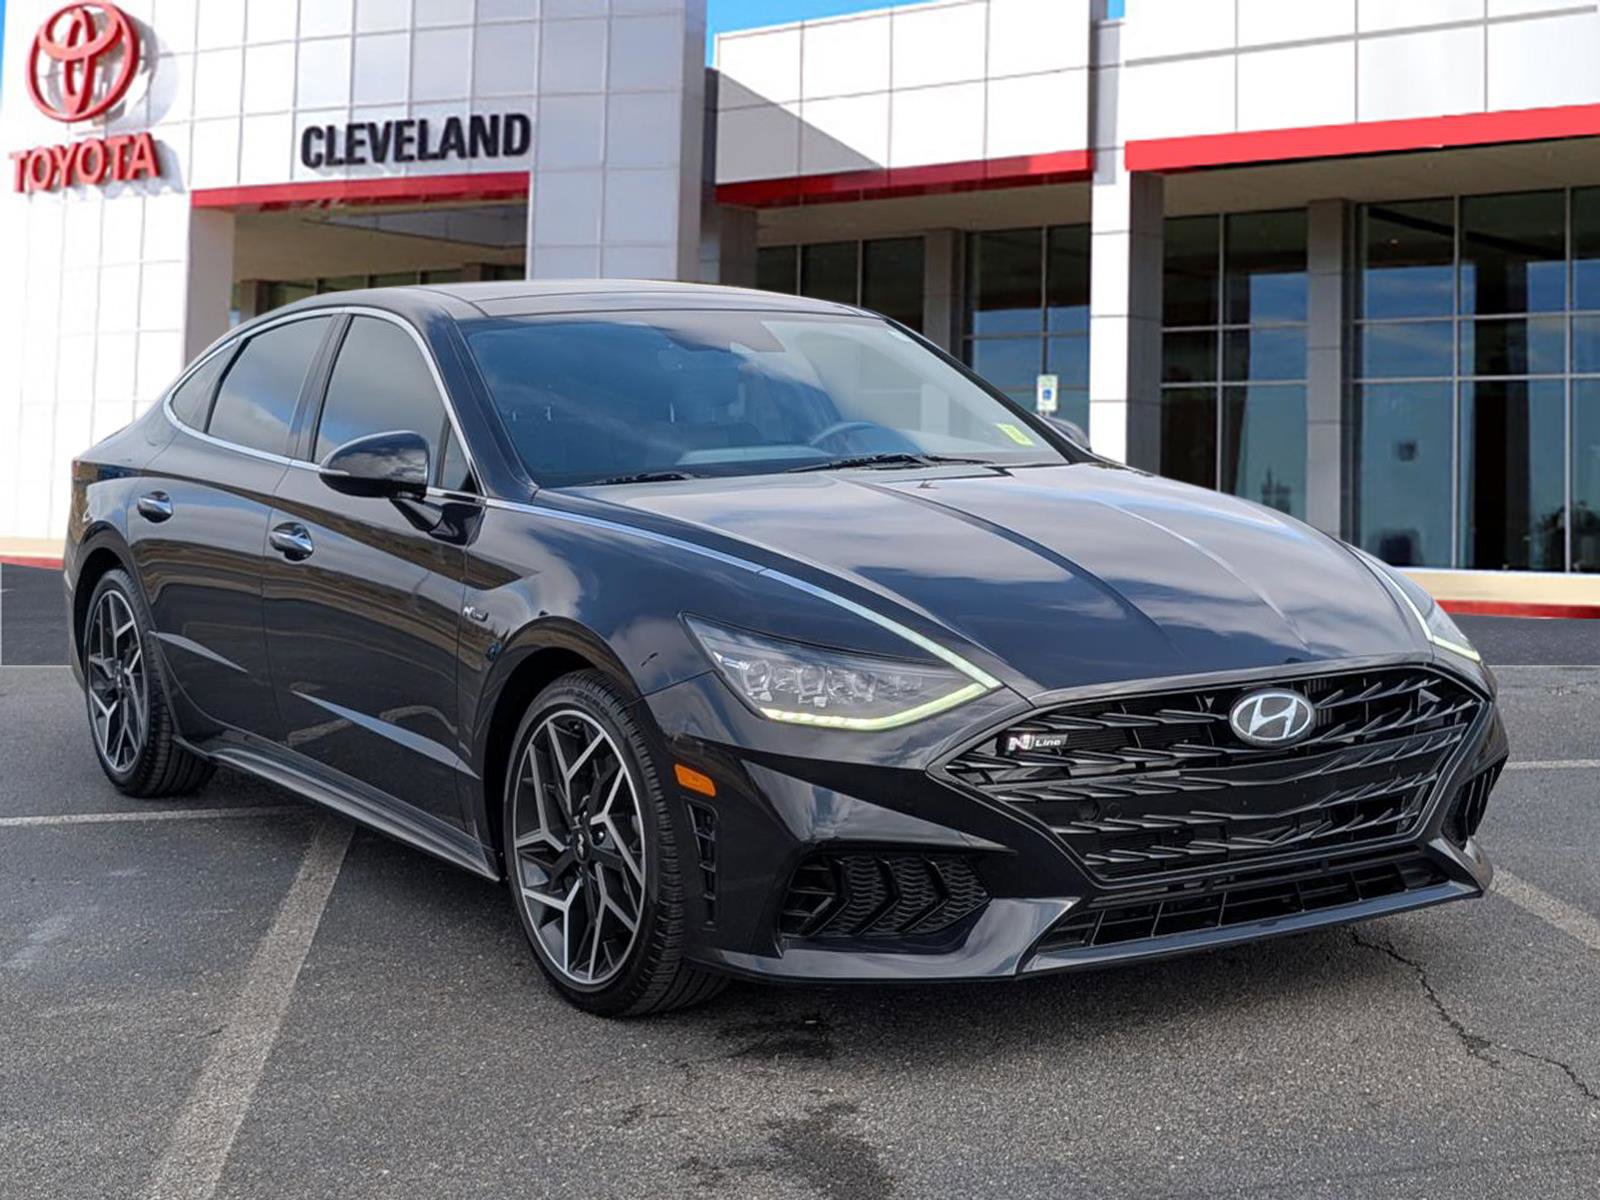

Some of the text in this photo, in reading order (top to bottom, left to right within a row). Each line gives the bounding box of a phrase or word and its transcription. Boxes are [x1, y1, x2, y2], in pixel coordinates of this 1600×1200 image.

[9, 131, 161, 193] TOYOTA
[301, 113, 531, 169] CLEVELAND
[1008, 734, 1062, 751] N Line
